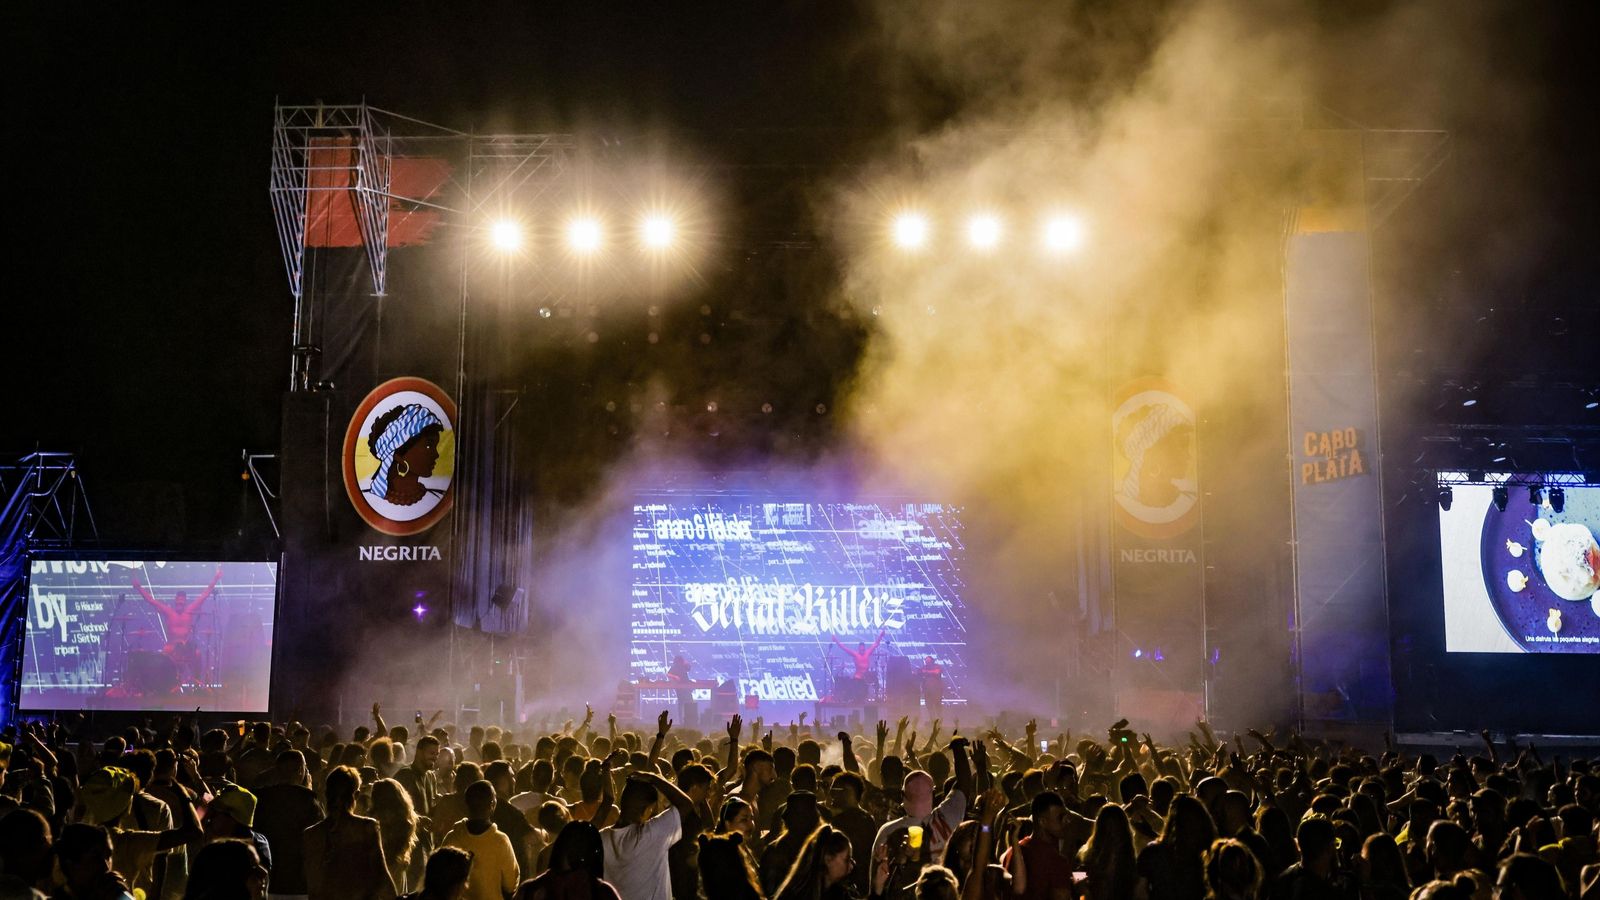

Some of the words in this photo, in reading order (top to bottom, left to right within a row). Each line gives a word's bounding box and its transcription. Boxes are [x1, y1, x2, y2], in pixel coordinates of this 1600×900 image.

[1304, 426, 1357, 457] CABO
[1302, 448, 1363, 485] PLATA
[657, 519, 695, 540] anaro
[359, 546, 441, 560] NEGRITA
[1120, 549, 1196, 563] NEGRITA
[32, 584, 67, 642] by
[738, 672, 819, 702] radiated
